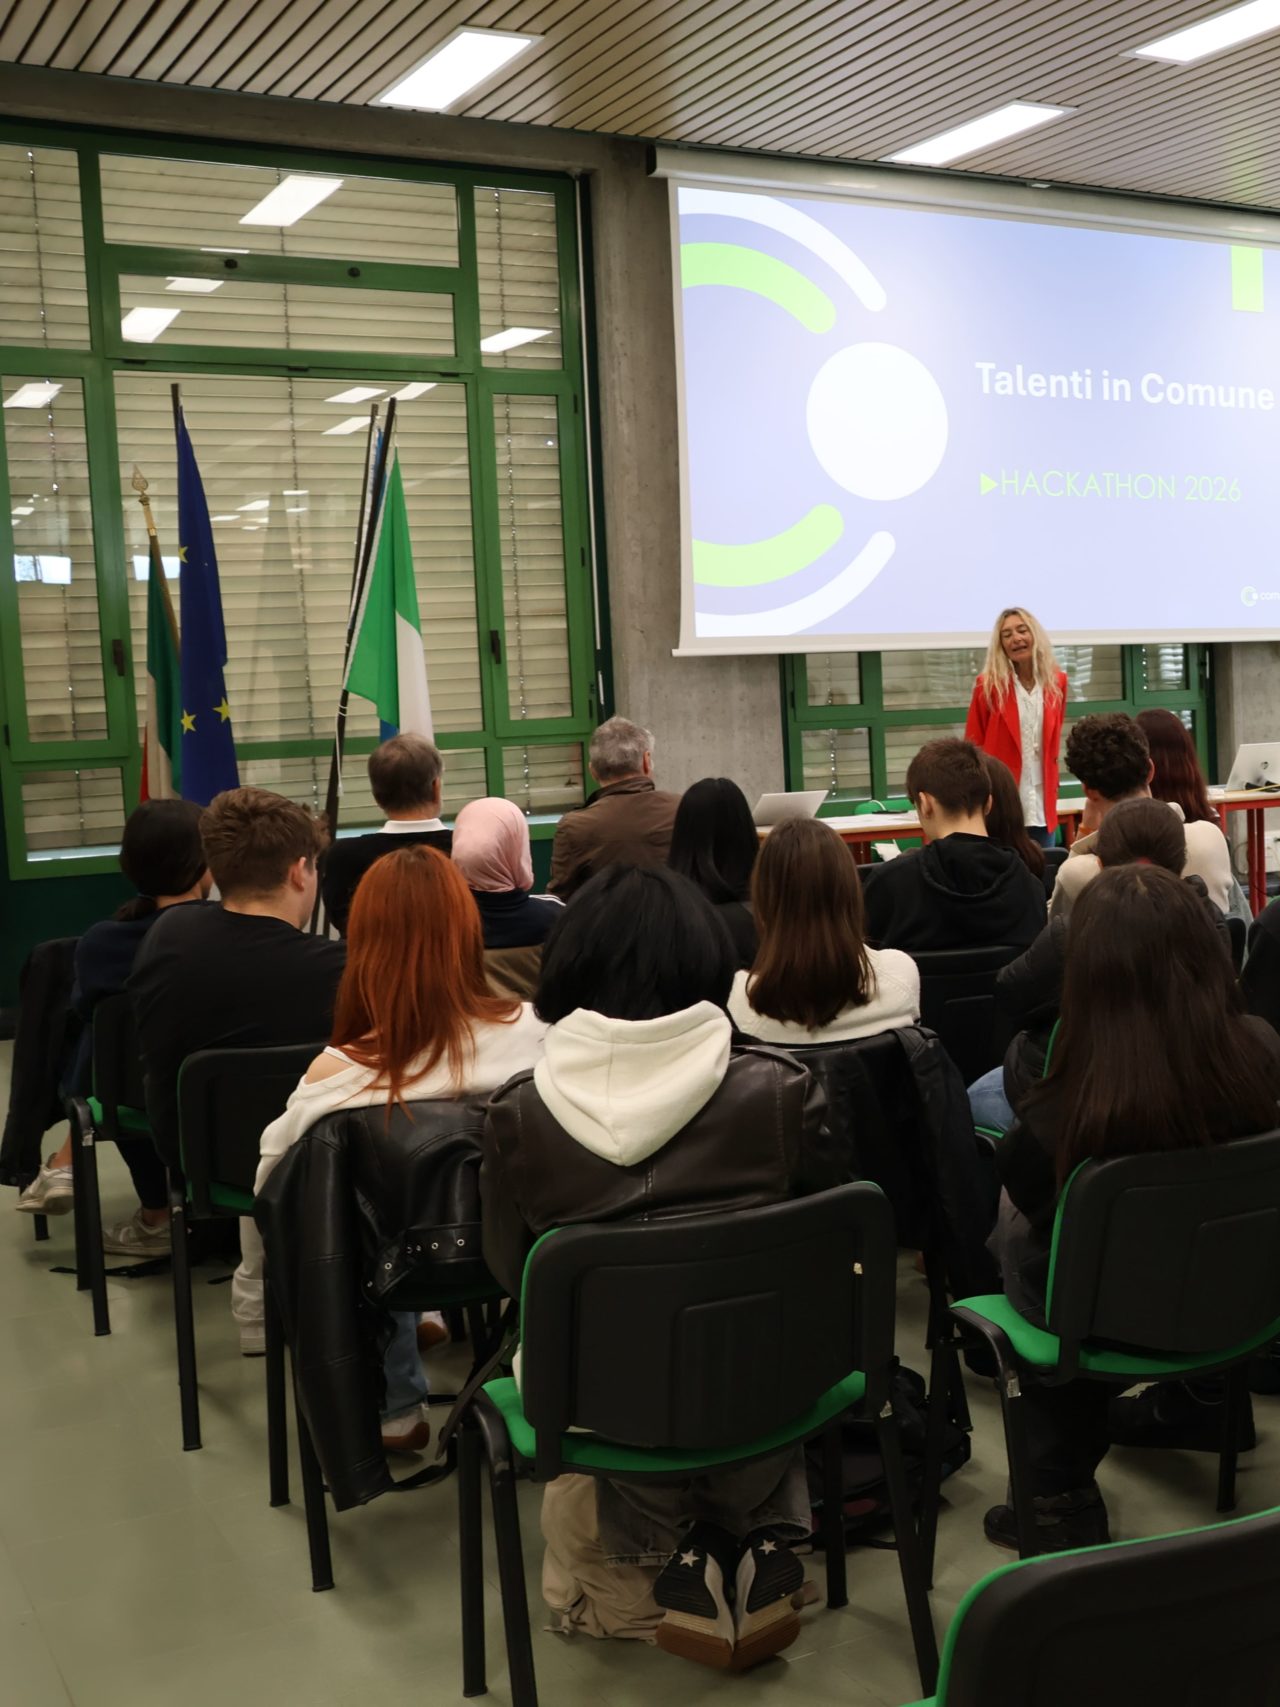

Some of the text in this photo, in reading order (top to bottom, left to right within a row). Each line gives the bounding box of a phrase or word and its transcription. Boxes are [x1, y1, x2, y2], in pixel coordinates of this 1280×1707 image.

[975, 361, 1276, 411] Talenti in Comune
[1001, 469, 1242, 502] HACKATHON 2026
